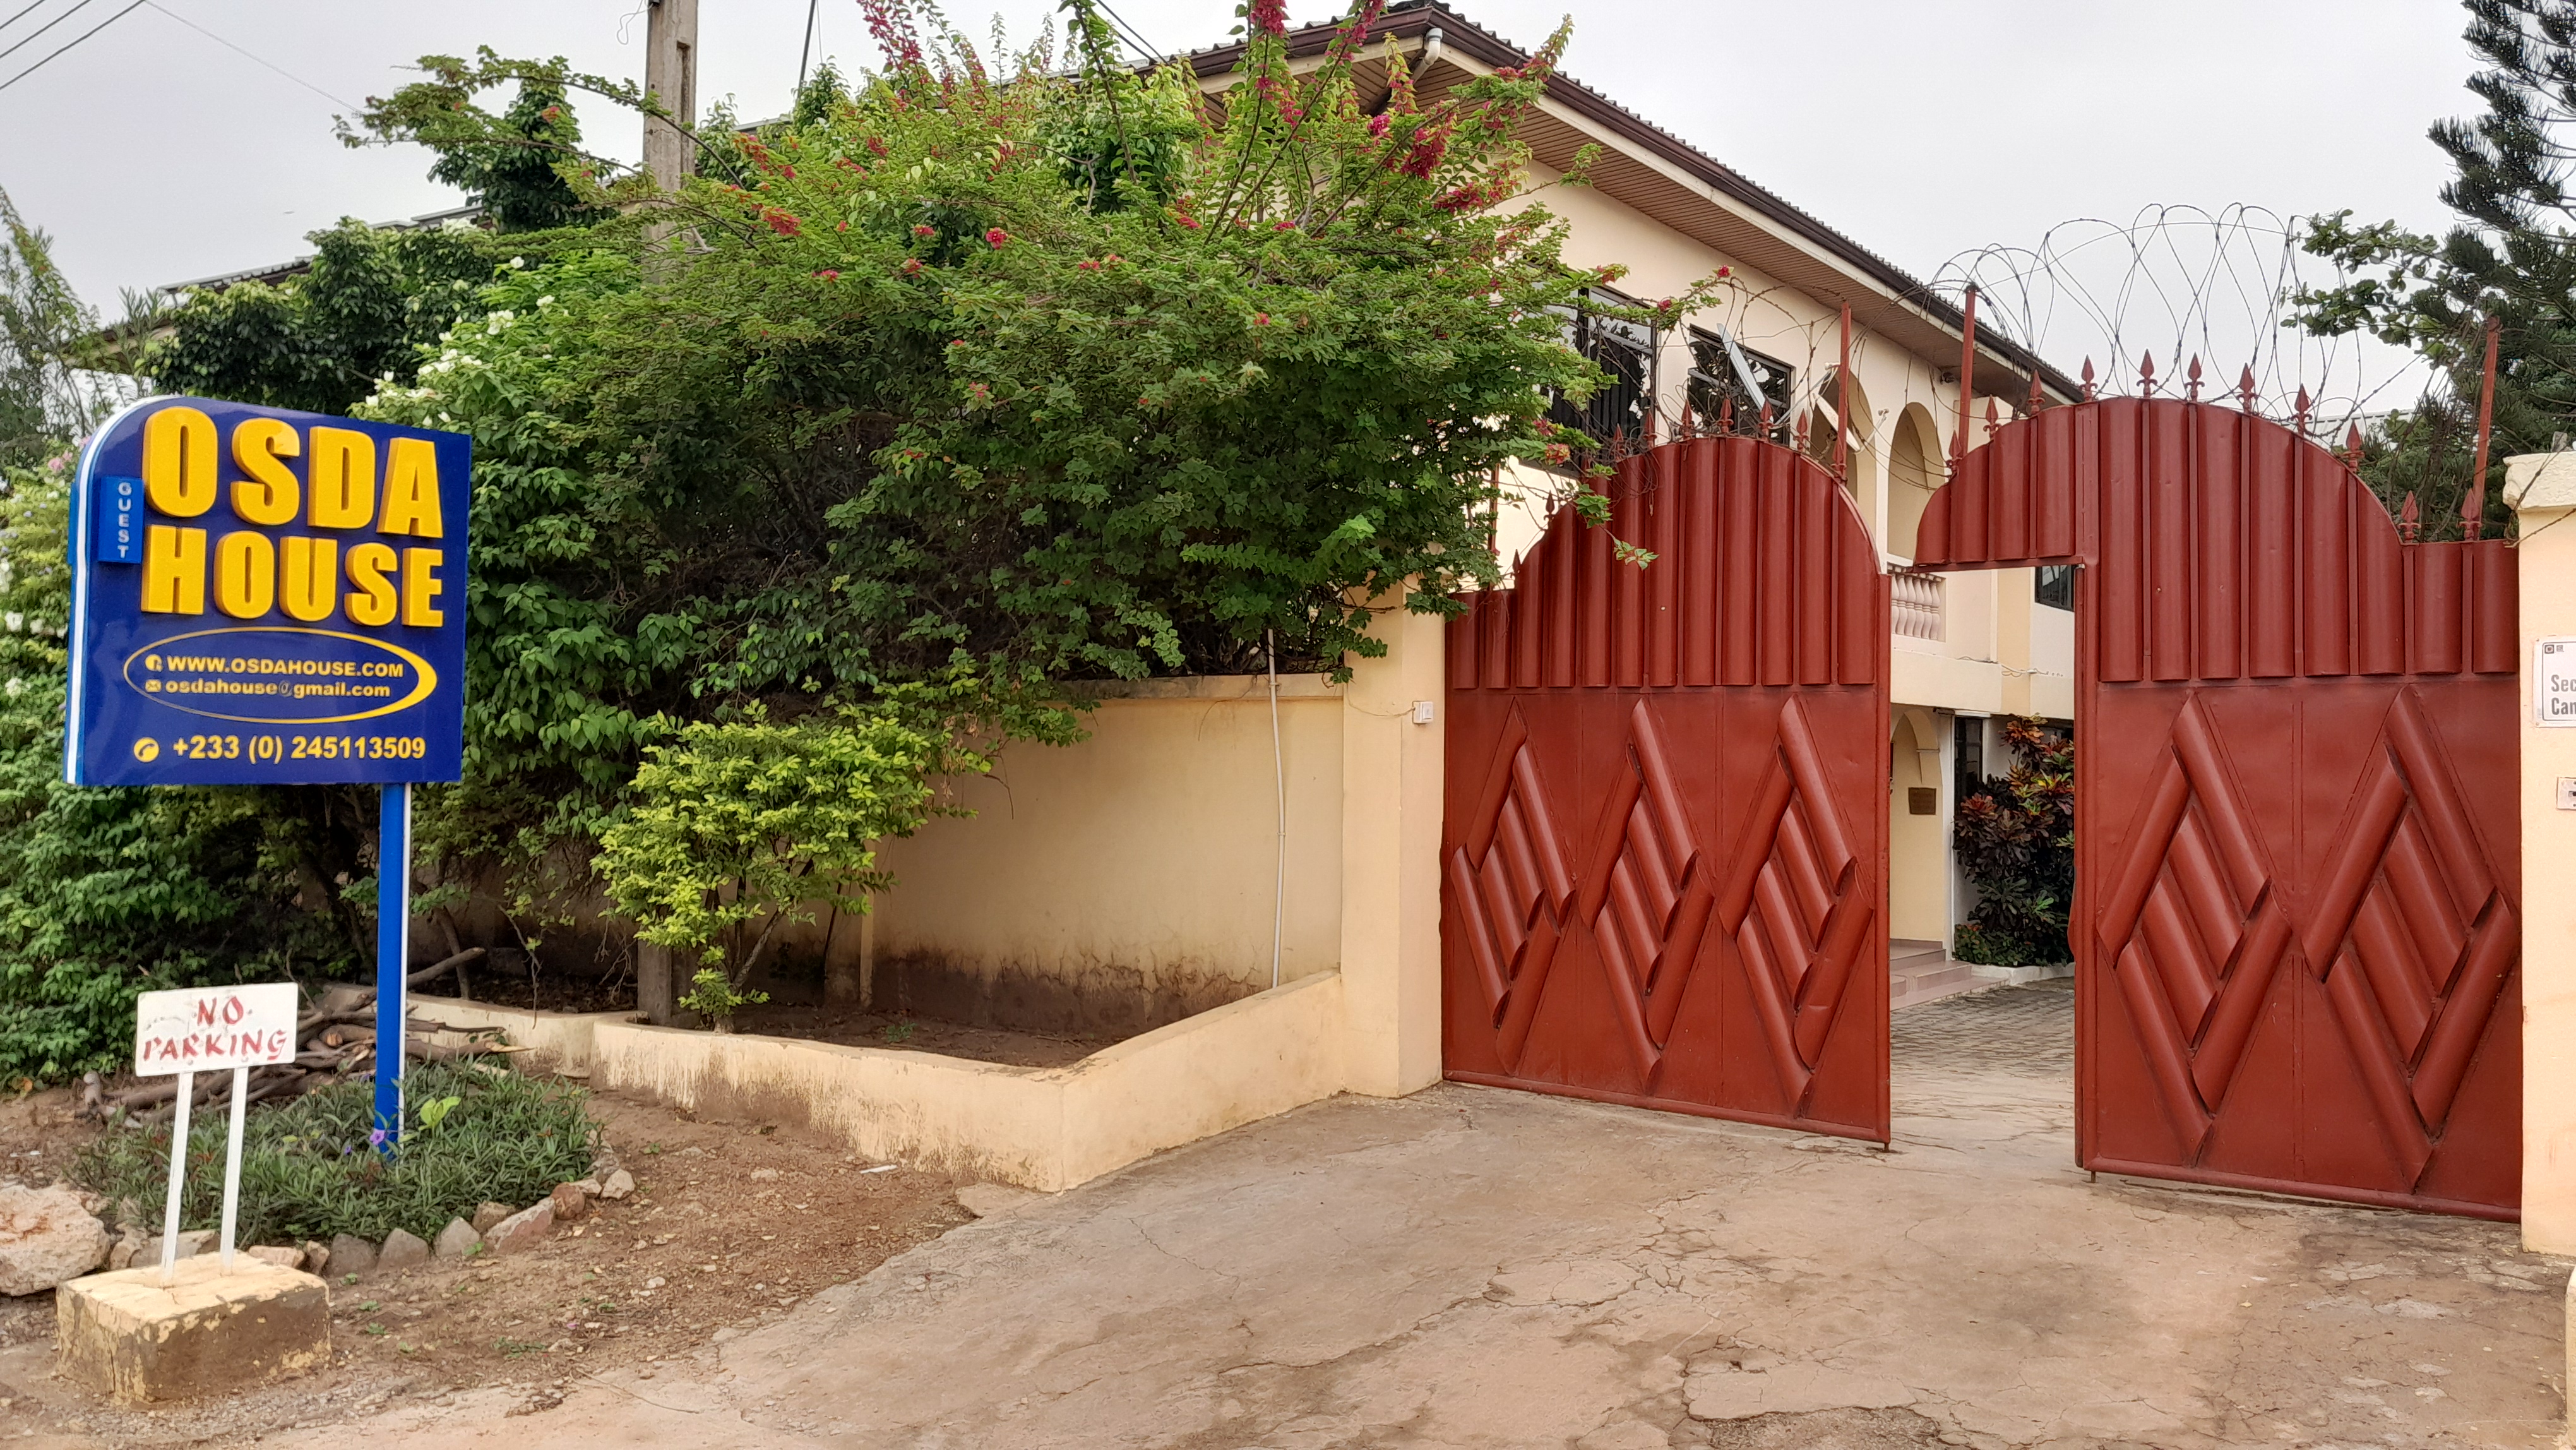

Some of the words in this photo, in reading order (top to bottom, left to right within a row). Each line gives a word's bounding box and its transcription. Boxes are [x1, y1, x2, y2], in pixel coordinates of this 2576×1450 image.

[142, 406, 443, 538] OSDA
[117, 481, 132, 559] GUEST
[140, 524, 443, 628] HOUSE
[166, 656, 403, 678] WWW.OSDAHOUSE.COM
[165, 678, 390, 699] osdahouse@gmail.com
[173, 734, 240, 759] +233
[249, 735, 283, 764] (0)
[290, 736, 426, 759] 245113509
[196, 996, 244, 1026] NO
[143, 1028, 287, 1062] PARKING
